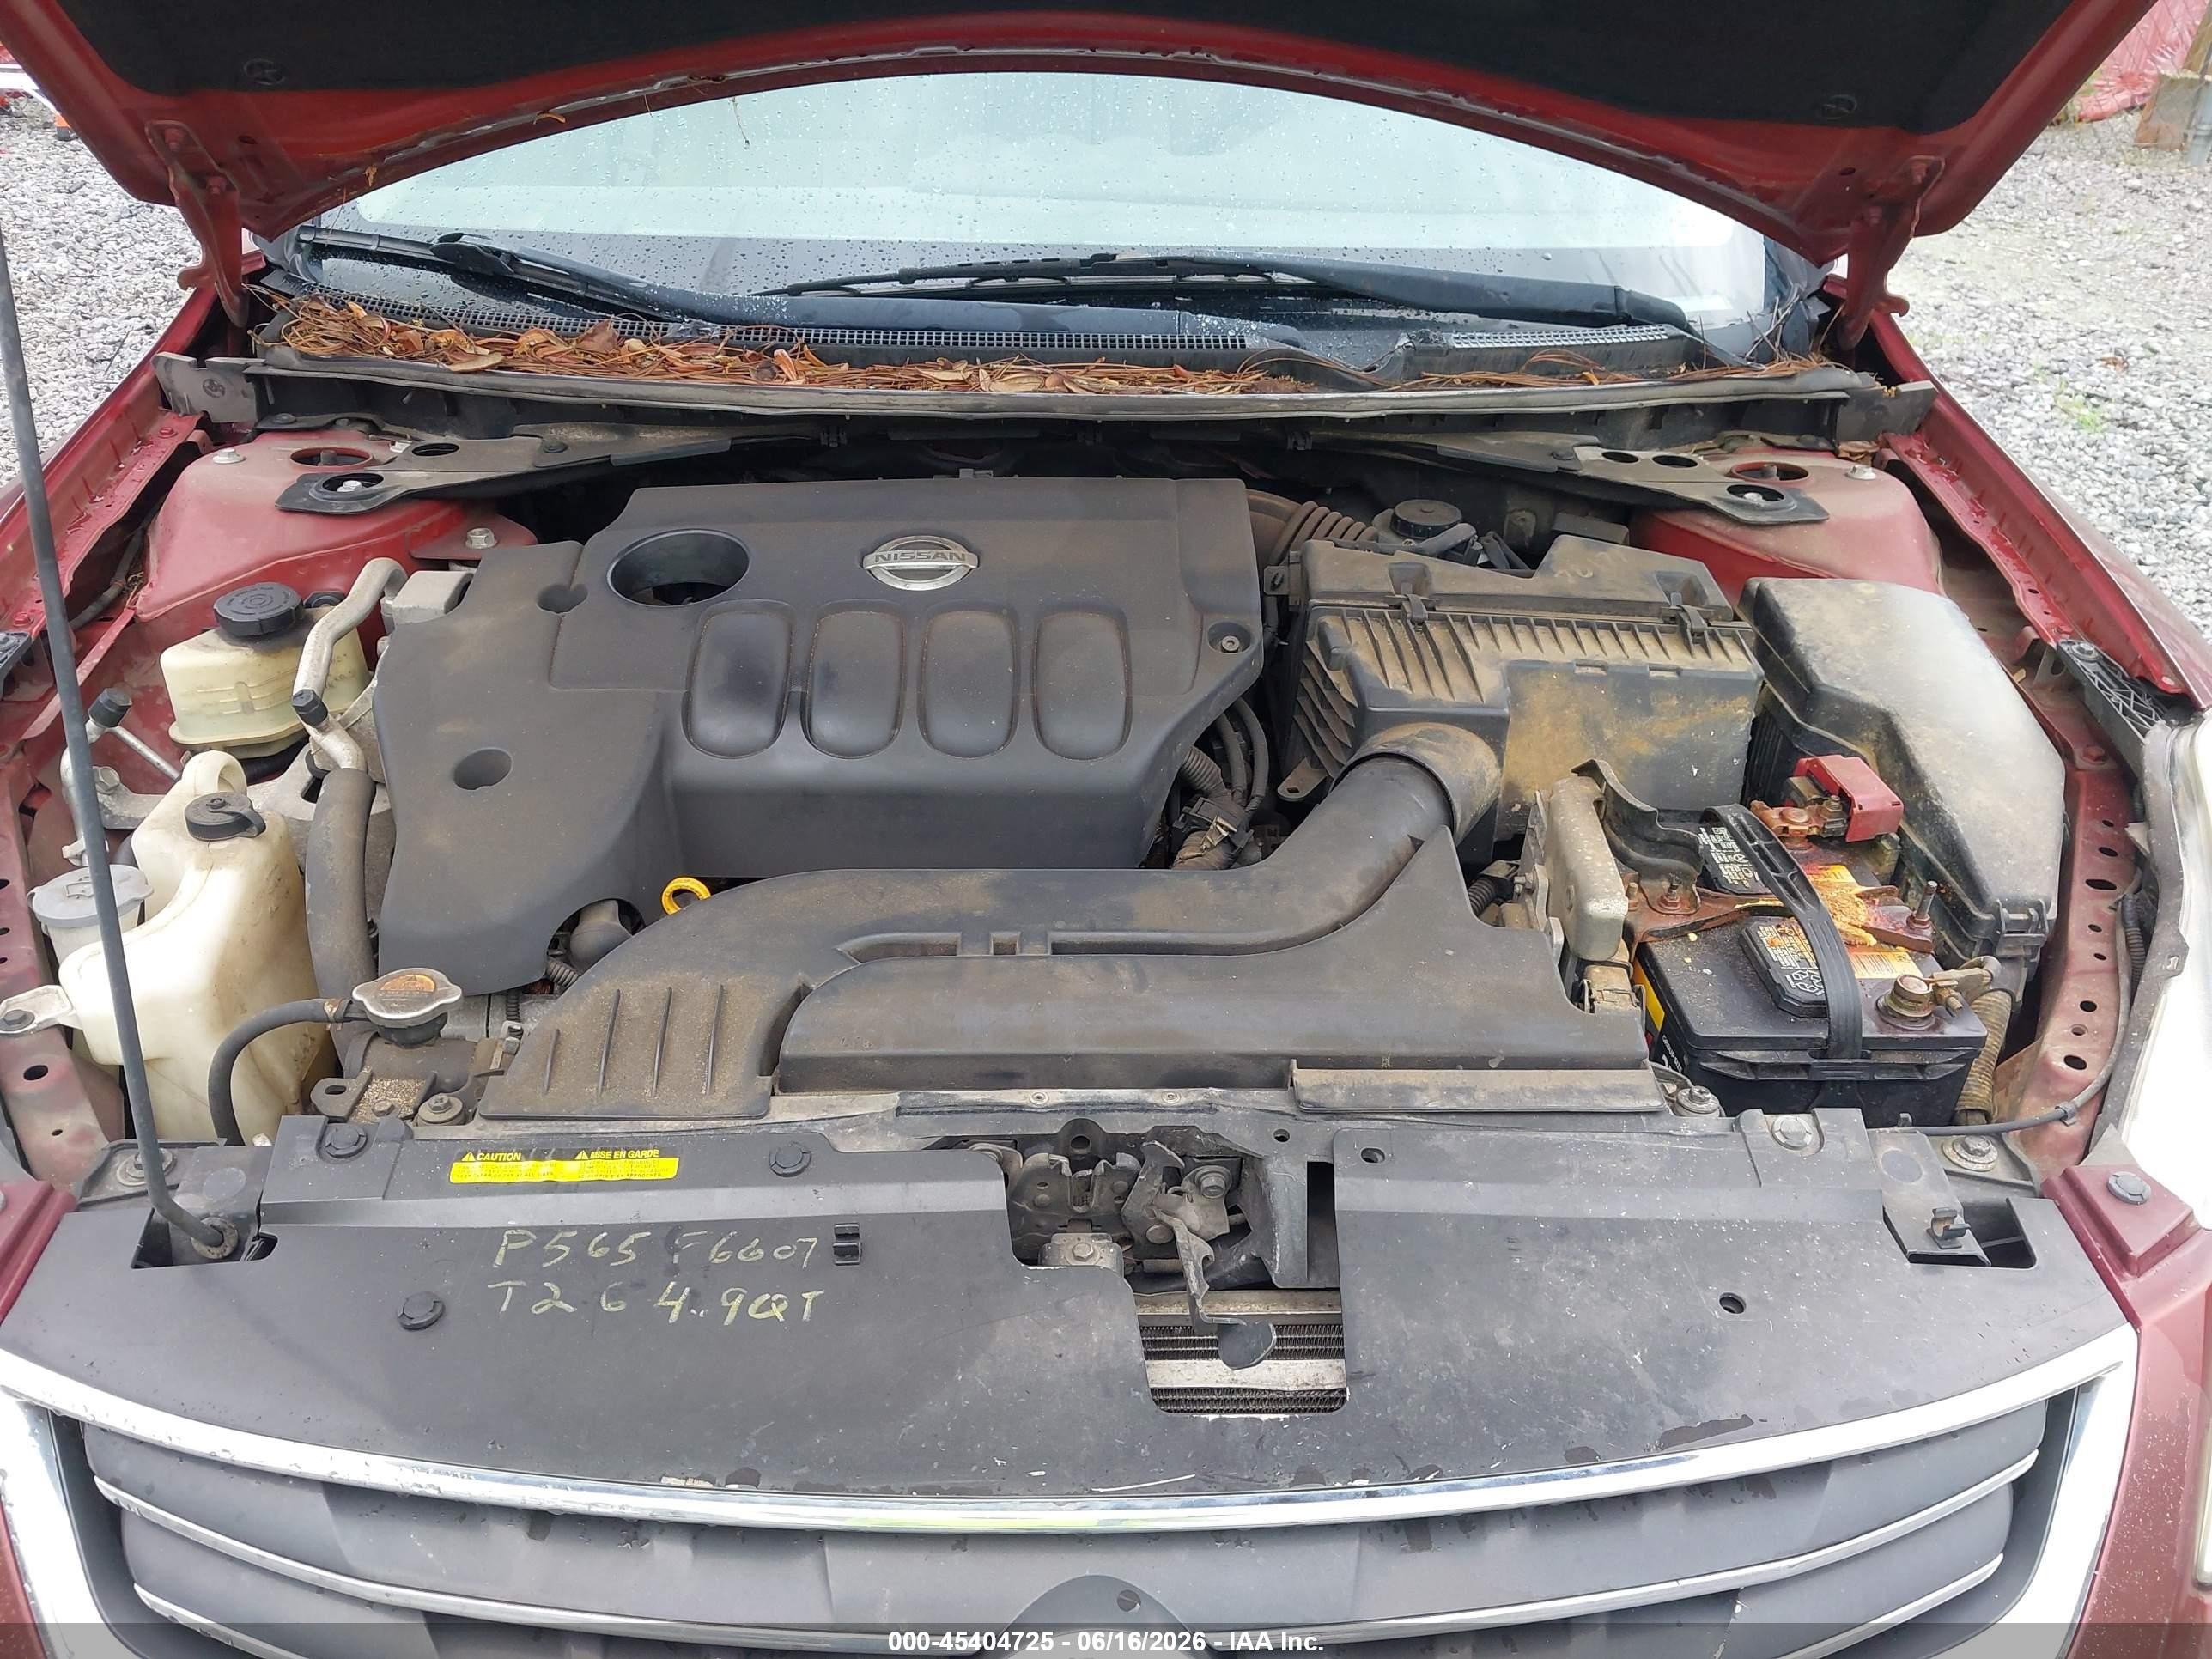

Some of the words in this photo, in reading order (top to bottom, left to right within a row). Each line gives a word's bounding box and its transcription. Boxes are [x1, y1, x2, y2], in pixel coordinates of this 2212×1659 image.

[875, 552, 966, 562] NISSAN
[1662, 1035, 1675, 1057] GROUP
[477, 1152, 522, 1161] CAUTION
[590, 1151, 612, 1159] MISE
[613, 1150, 627, 1159] EN
[628, 1149, 659, 1158] GARDE
